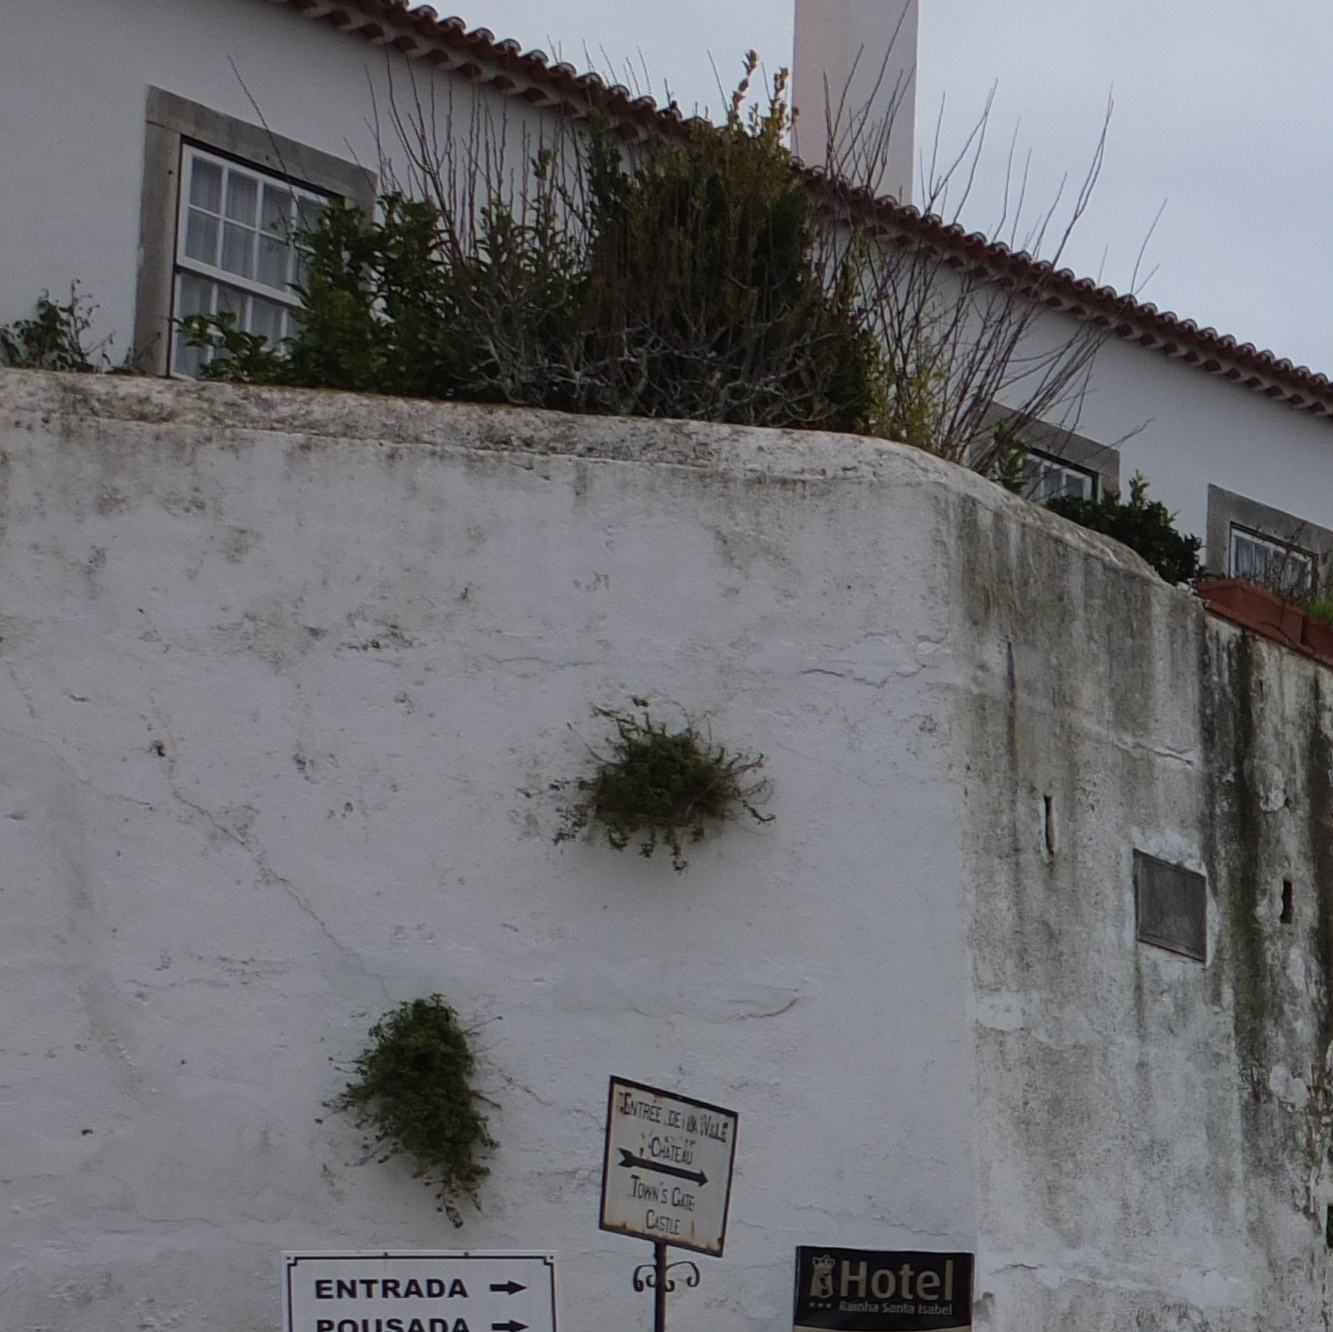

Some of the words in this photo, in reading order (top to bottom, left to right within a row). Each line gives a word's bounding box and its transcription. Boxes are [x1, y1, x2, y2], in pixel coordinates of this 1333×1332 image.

[646, 1209, 681, 1235] CASTLE
[315, 1278, 469, 1300] ENTRADA
[840, 1259, 954, 1301] Hotel
[840, 1301, 879, 1313] Rainha
[882, 1302, 915, 1315] Santa
[918, 1304, 953, 1316] Isabel
